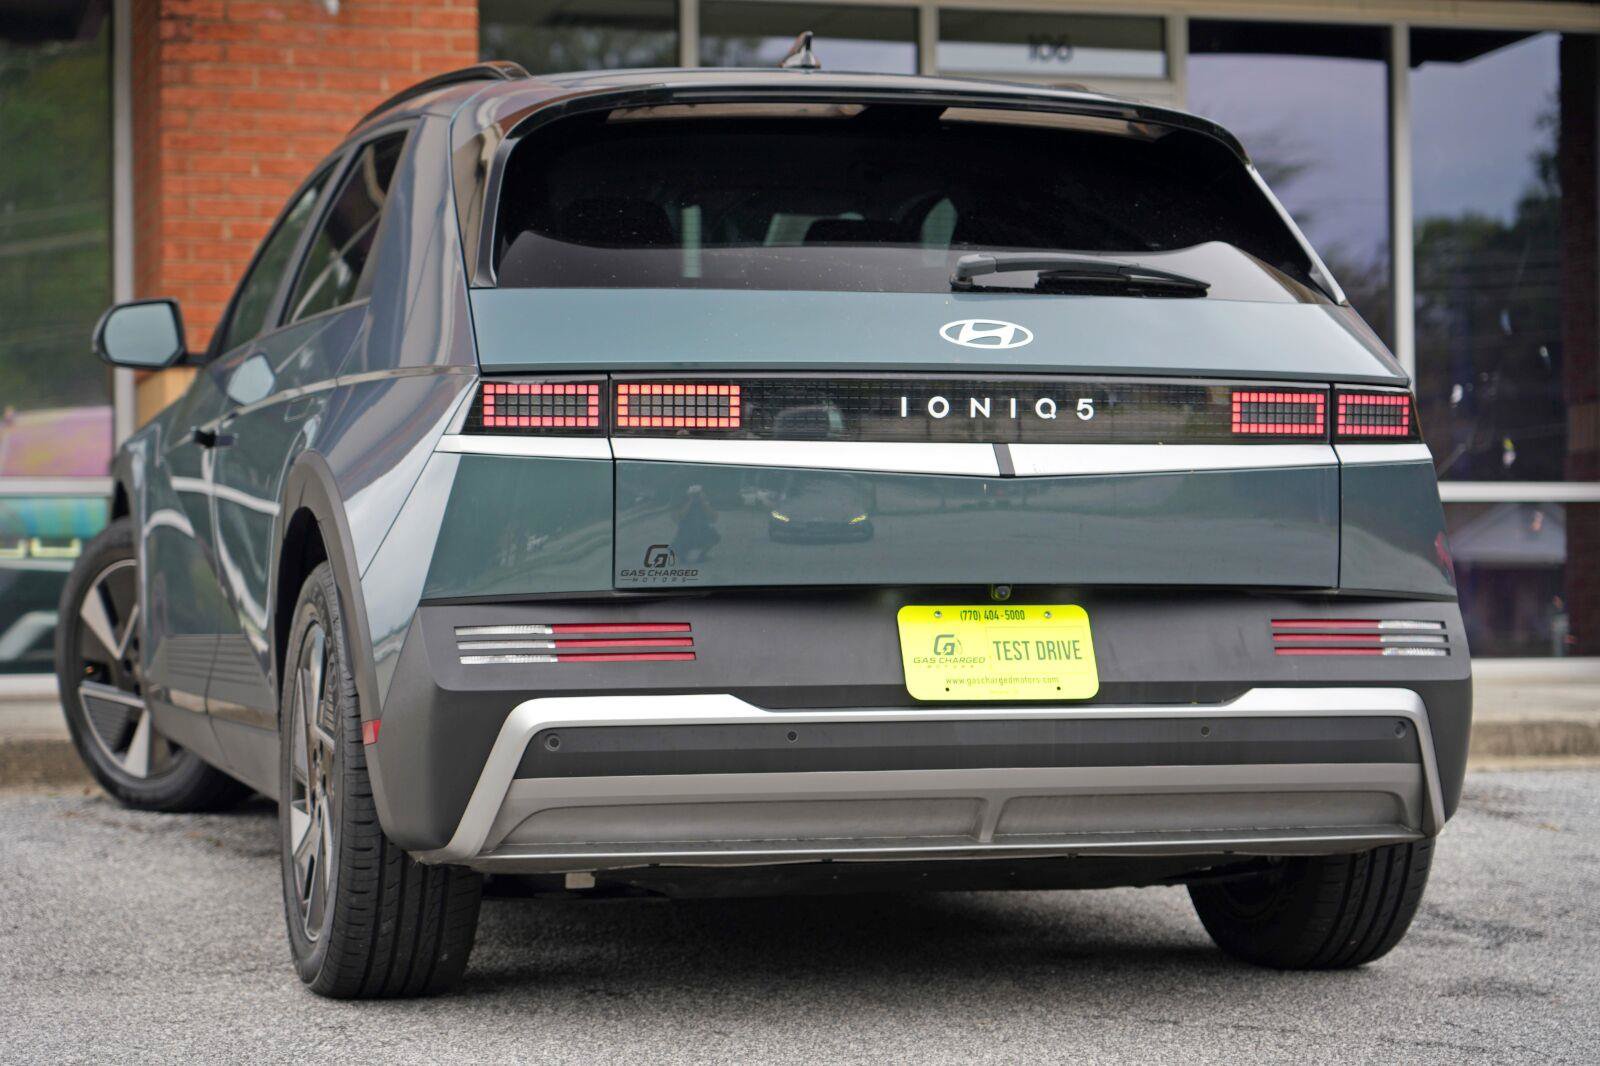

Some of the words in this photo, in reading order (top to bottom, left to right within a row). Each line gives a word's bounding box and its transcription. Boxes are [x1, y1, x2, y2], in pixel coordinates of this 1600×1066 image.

[900, 396, 1057, 420] IONIQ
[1076, 398, 1095, 421] 5
[621, 569, 646, 577] GAS
[647, 569, 699, 577] CHARGED
[959, 609, 982, 621] (770)
[993, 640, 1031, 661] TEST
[1036, 640, 1083, 660] DRIVE
[945, 675, 1060, 686] www.gaschargedmotors.com
